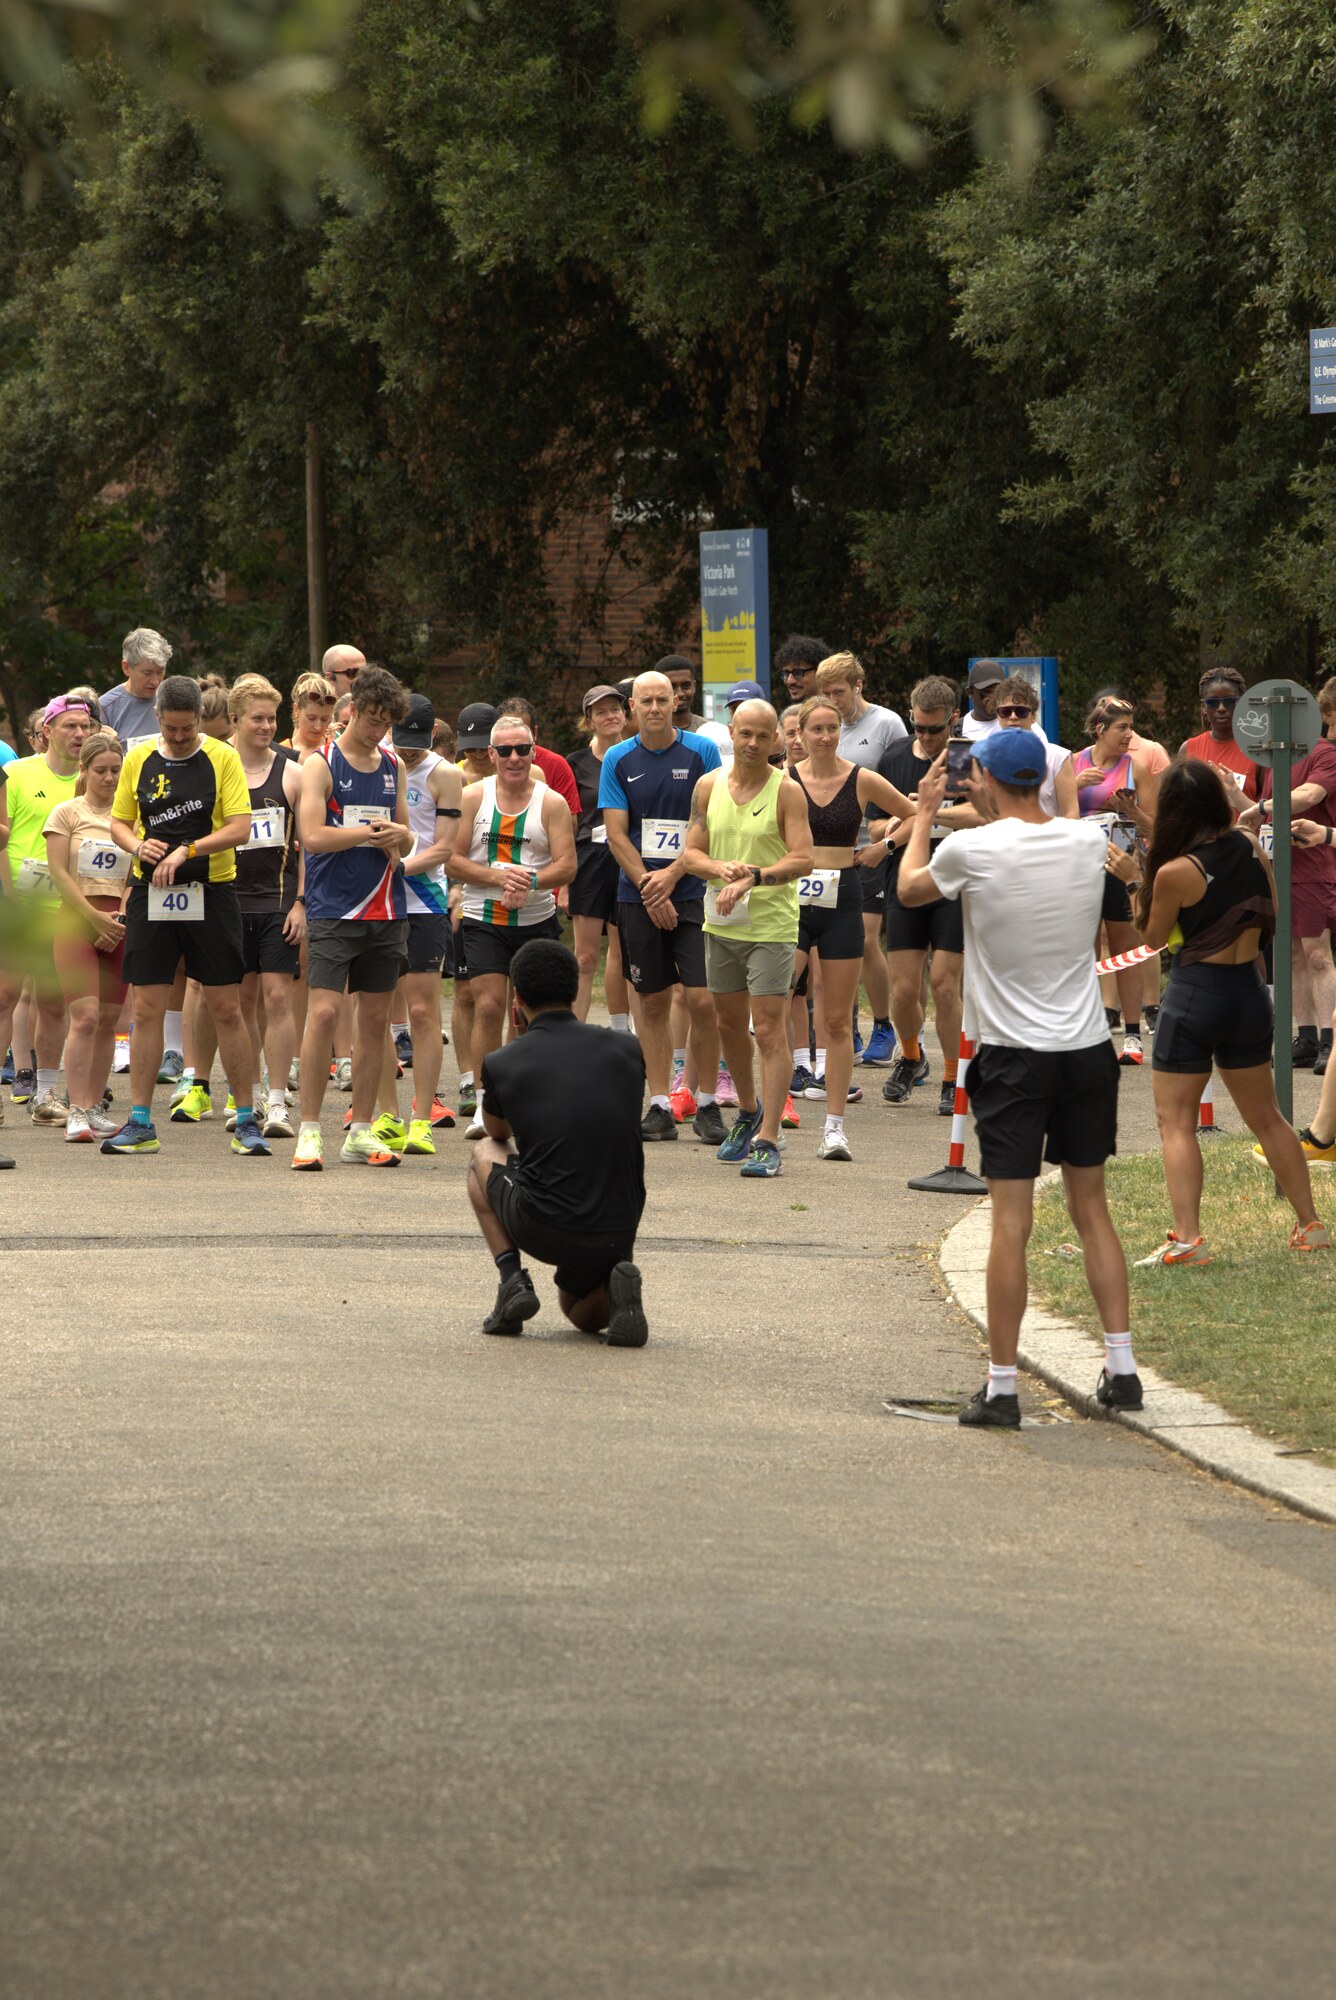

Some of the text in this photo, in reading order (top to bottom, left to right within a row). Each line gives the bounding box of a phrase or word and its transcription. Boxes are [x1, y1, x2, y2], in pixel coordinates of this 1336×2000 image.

[703, 564, 735, 580] Victoria Park
[148, 800, 203, 827] Run&Frite
[251, 821, 272, 839] 11
[655, 832, 681, 850] 74
[92, 852, 117, 869] 49
[799, 879, 824, 897] 29
[162, 892, 189, 911] 40
